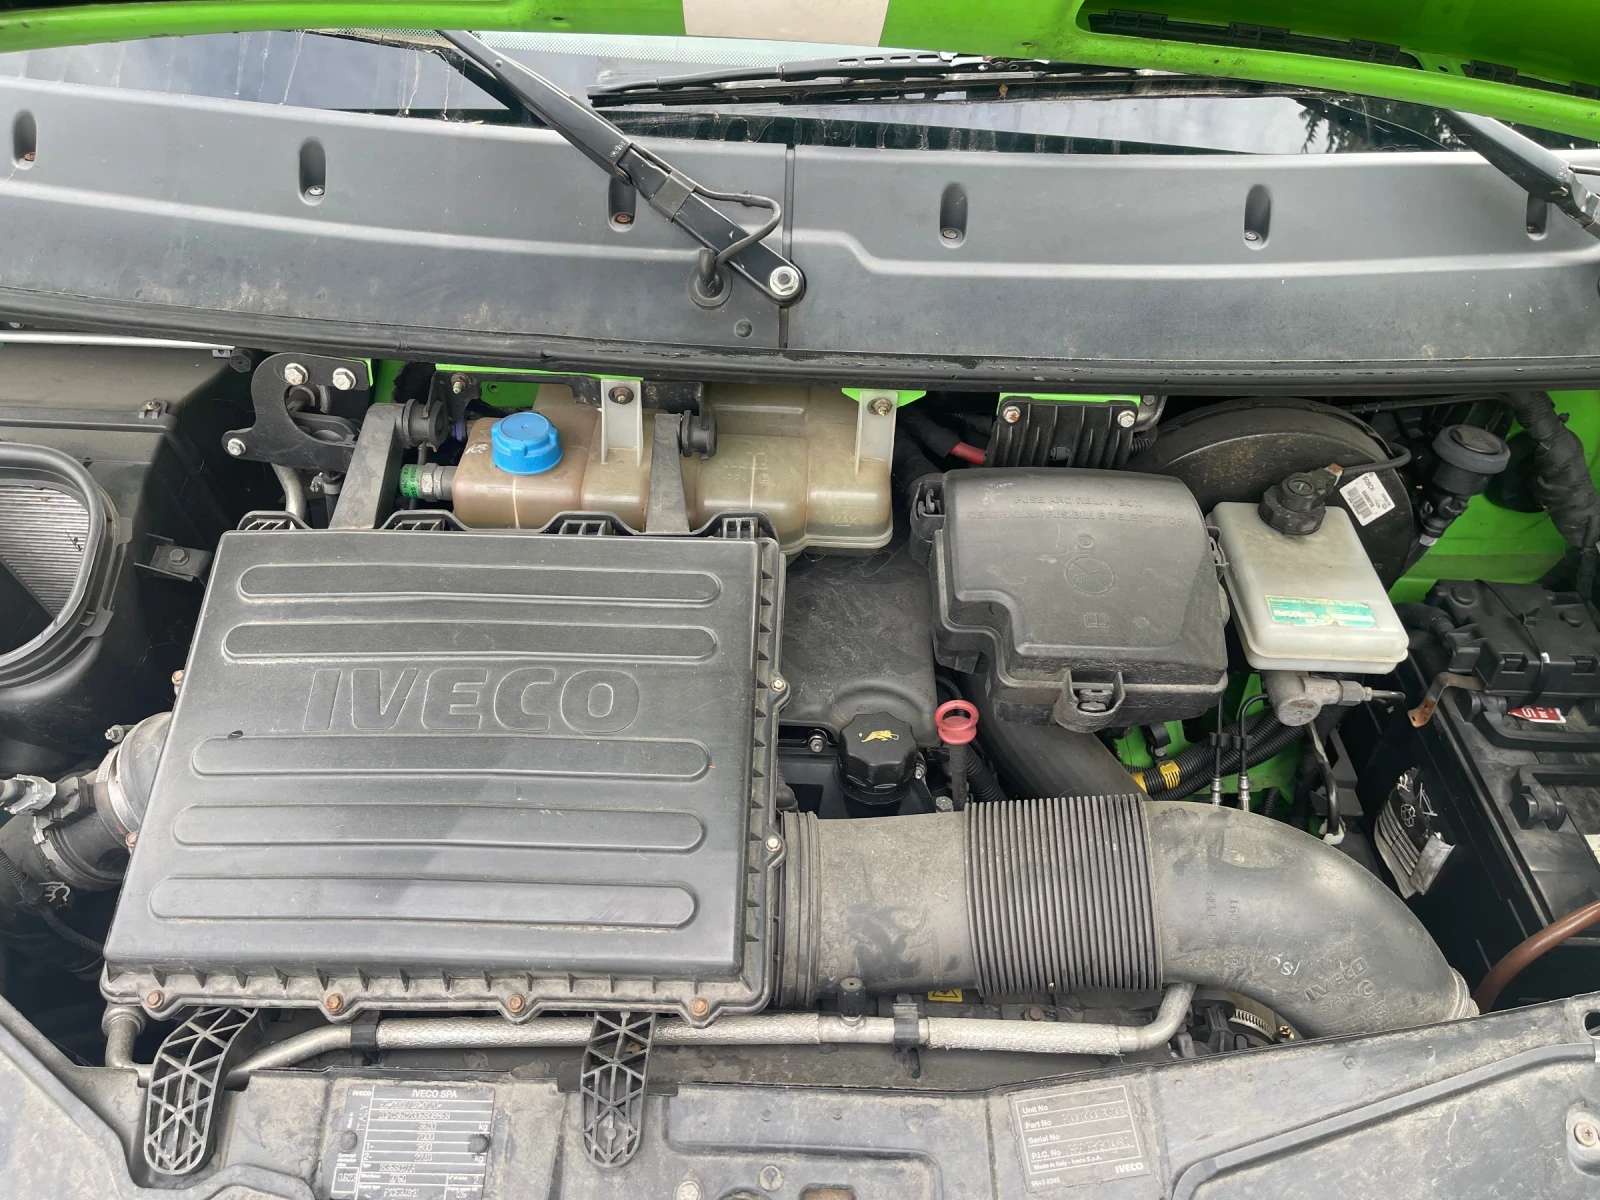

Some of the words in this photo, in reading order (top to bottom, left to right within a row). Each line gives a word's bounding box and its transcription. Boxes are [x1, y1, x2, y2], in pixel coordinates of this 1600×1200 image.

[1362, 475, 1375, 491] BOSCH
[1014, 496, 1045, 504] FUSE
[1048, 496, 1073, 504] AND
[1076, 496, 1114, 506] RELAY
[1119, 498, 1143, 508] BOX
[1046, 510, 1094, 520] FUSIBILI
[302, 667, 640, 734] IVECO
[1304, 956, 1368, 1003] IVECO
[412, 1089, 439, 1098] IVECO
[440, 1089, 458, 1099] SPA
[1022, 1105, 1037, 1114] Unit
[356, 1103, 369, 1131] ITALY
[478, 1123, 489, 1132] kg
[1025, 1120, 1041, 1130] Part
[416, 1132, 435, 1141] 7000
[1028, 1135, 1049, 1145] Serial
[1050, 1133, 1060, 1142] No
[474, 1155, 484, 1164] kg
[1031, 1151, 1050, 1160] P.I.C.
[1051, 1149, 1061, 1157] No
[1055, 1160, 1067, 1168] Italy
[1115, 1162, 1144, 1173] IVECO
[473, 1176, 480, 1185] 2
